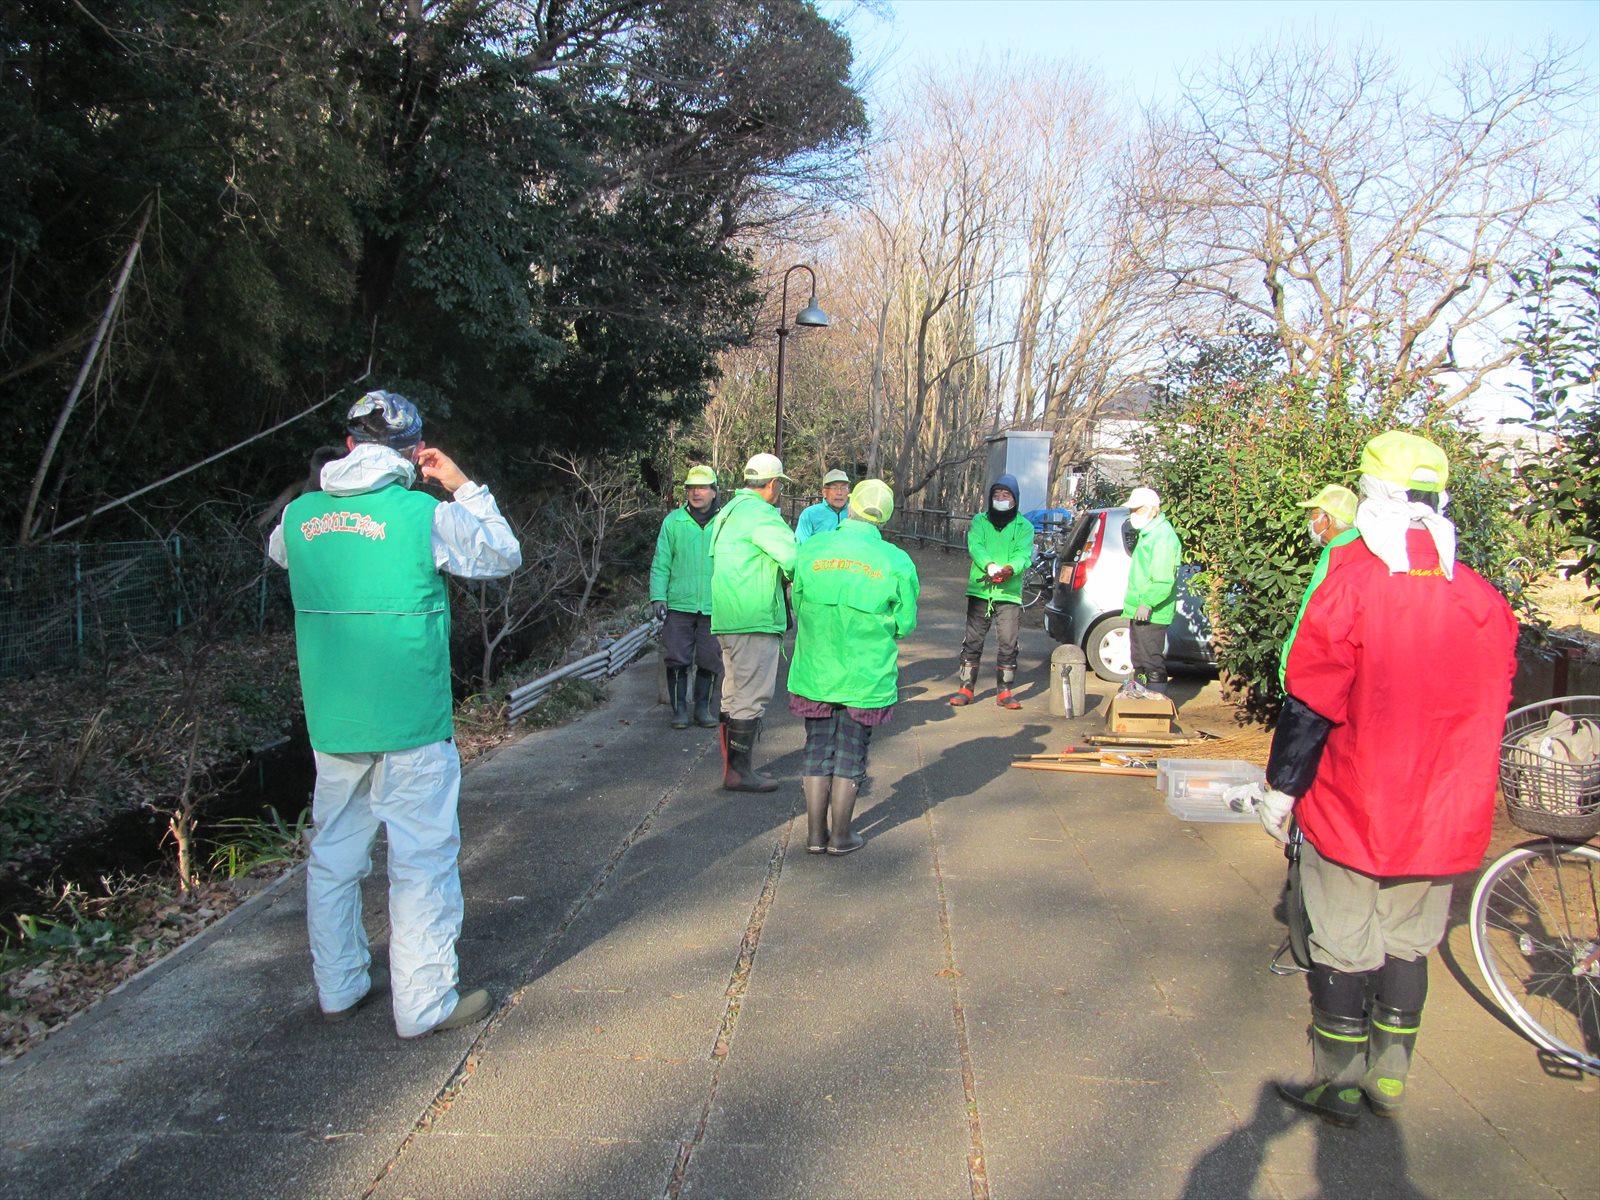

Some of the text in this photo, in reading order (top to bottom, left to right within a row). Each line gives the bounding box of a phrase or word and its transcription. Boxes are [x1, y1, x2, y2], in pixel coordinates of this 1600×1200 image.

[300, 511, 387, 541] さむかわエコネット
